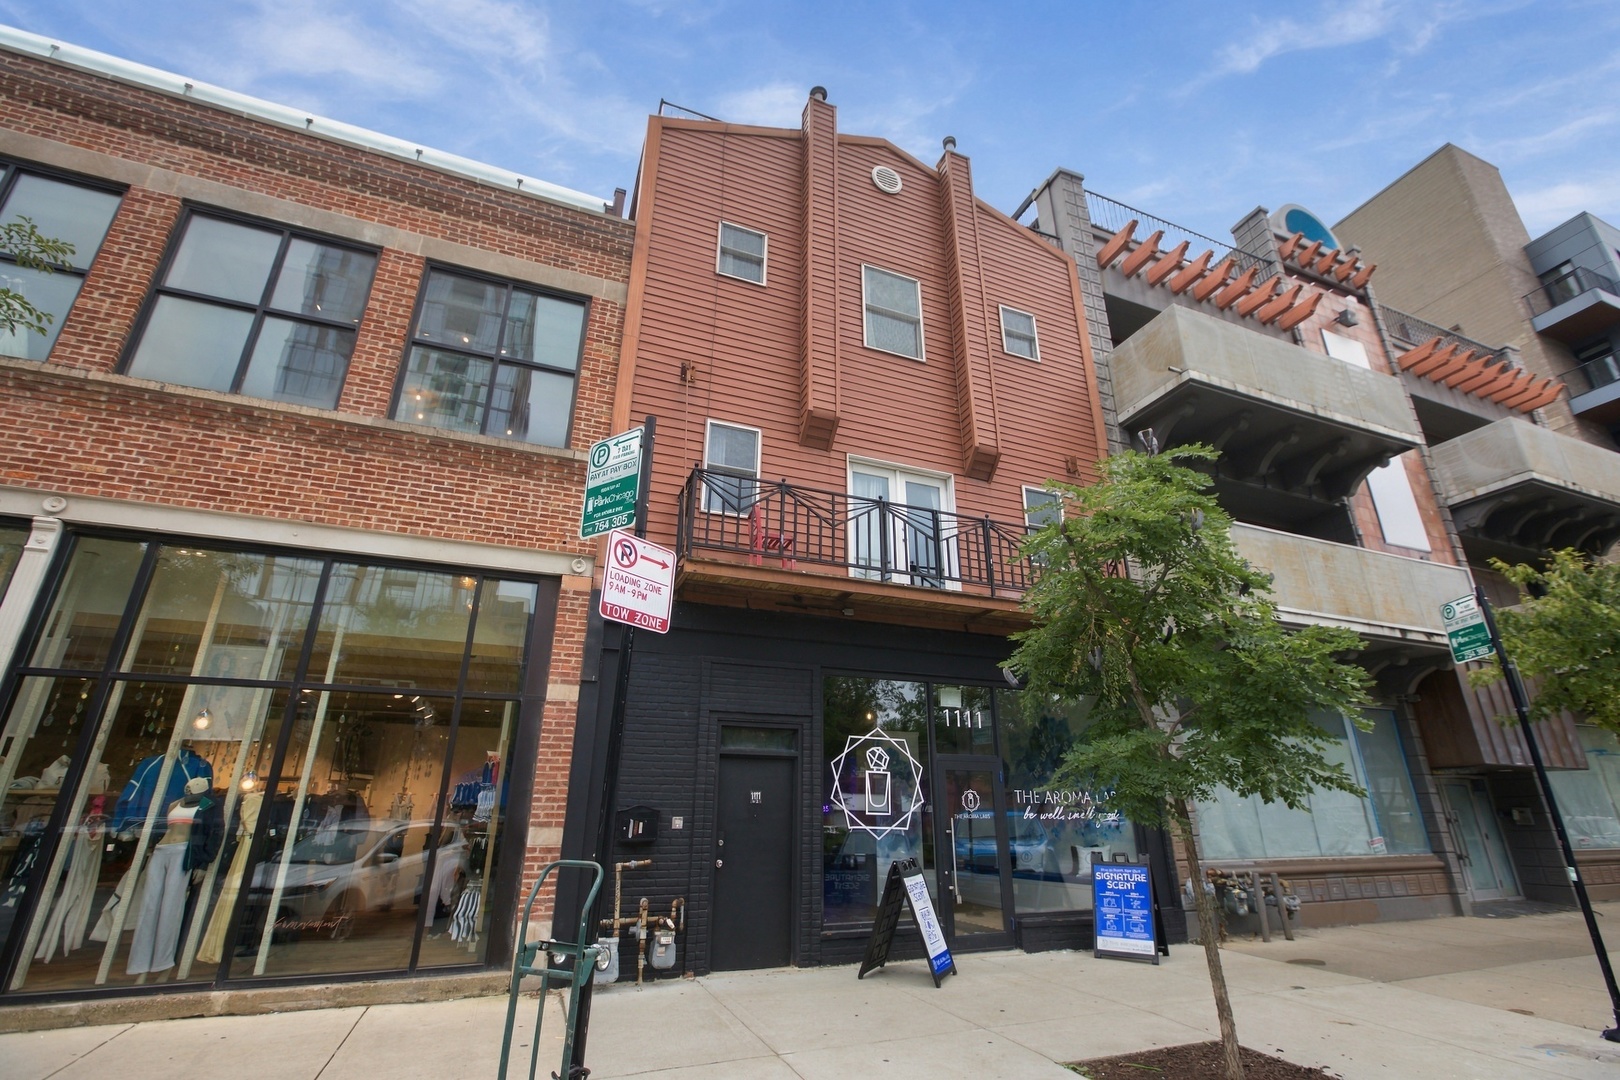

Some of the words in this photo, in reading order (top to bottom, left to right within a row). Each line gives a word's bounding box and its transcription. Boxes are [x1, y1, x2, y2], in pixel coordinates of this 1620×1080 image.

[590, 471, 601, 481] PAY
[601, 468, 609, 477] AT
[610, 465, 622, 475] PAY
[623, 460, 637, 470] BOX
[594, 490, 634, 507] ParkChicago
[611, 514, 628, 527] 305
[609, 570, 641, 589] LOADING
[643, 582, 663, 596] ZONE
[605, 603, 630, 620] TOW
[634, 612, 663, 630] ZONE
[943, 709, 982, 729] 1111
[1014, 789, 1041, 804] THE
[1044, 790, 1092, 804] AROMA
[1023, 805, 1037, 820] be
[1095, 871, 1147, 882] SIGNATURE
[1106, 881, 1137, 890] SCENT
